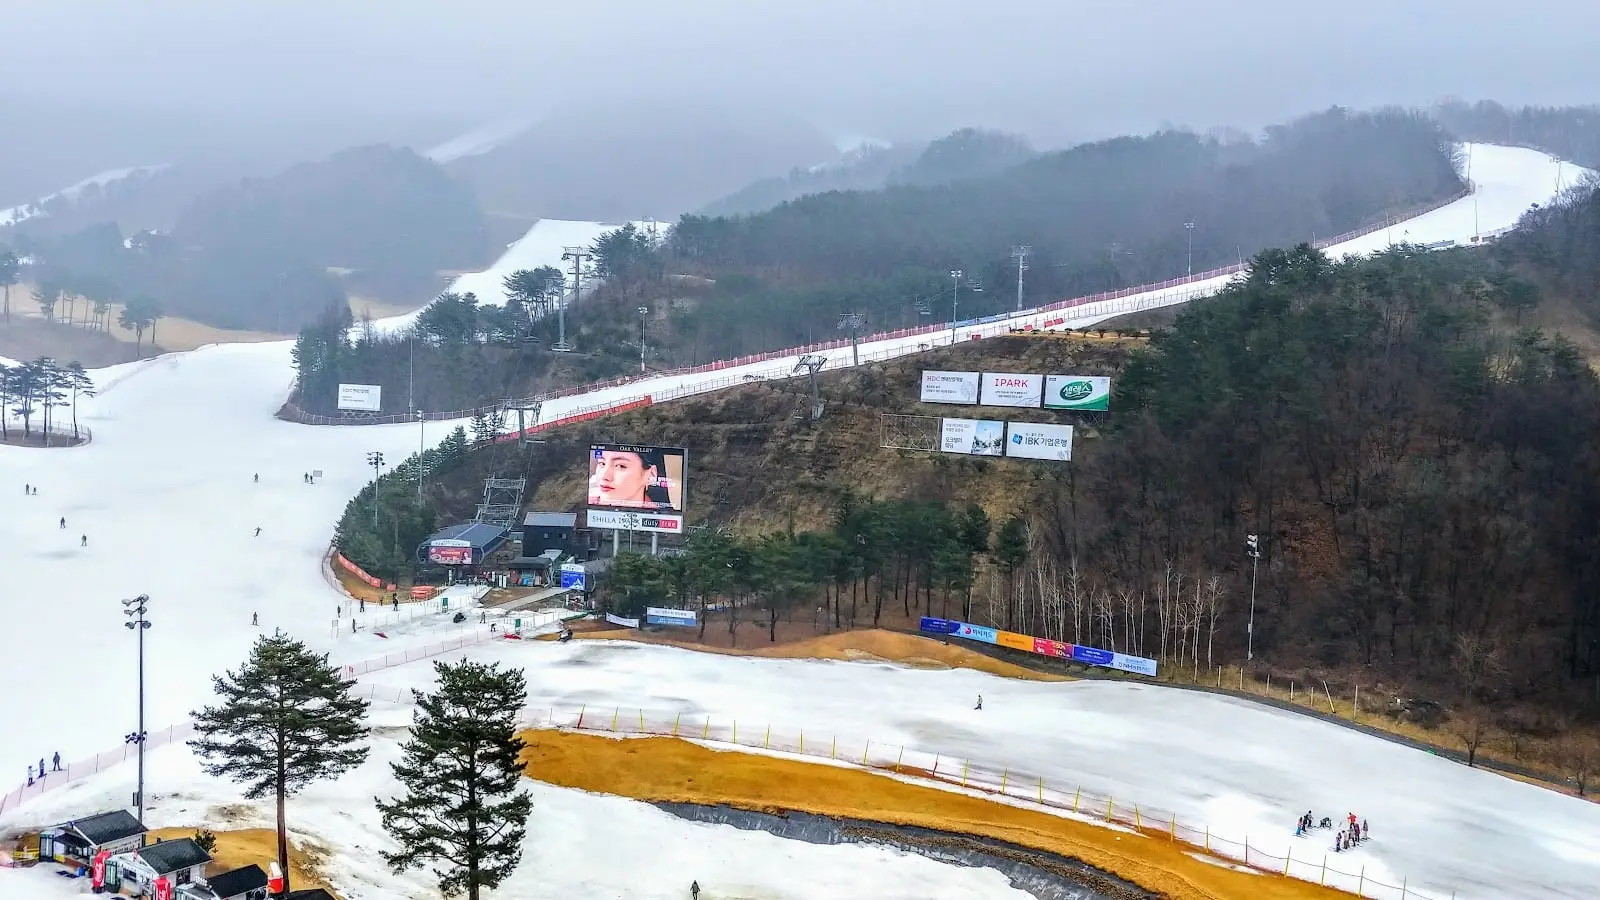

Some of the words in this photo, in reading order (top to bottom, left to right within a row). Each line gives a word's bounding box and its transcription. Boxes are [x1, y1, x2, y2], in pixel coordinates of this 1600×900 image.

[994, 377, 1029, 388] IPARK
[1062, 380, 1093, 397] 셀렉스
[1025, 436, 1040, 446] IBK
[1040, 437, 1068, 448] 기업은행
[592, 516, 616, 524] SHILLA
[643, 518, 659, 528] duty
